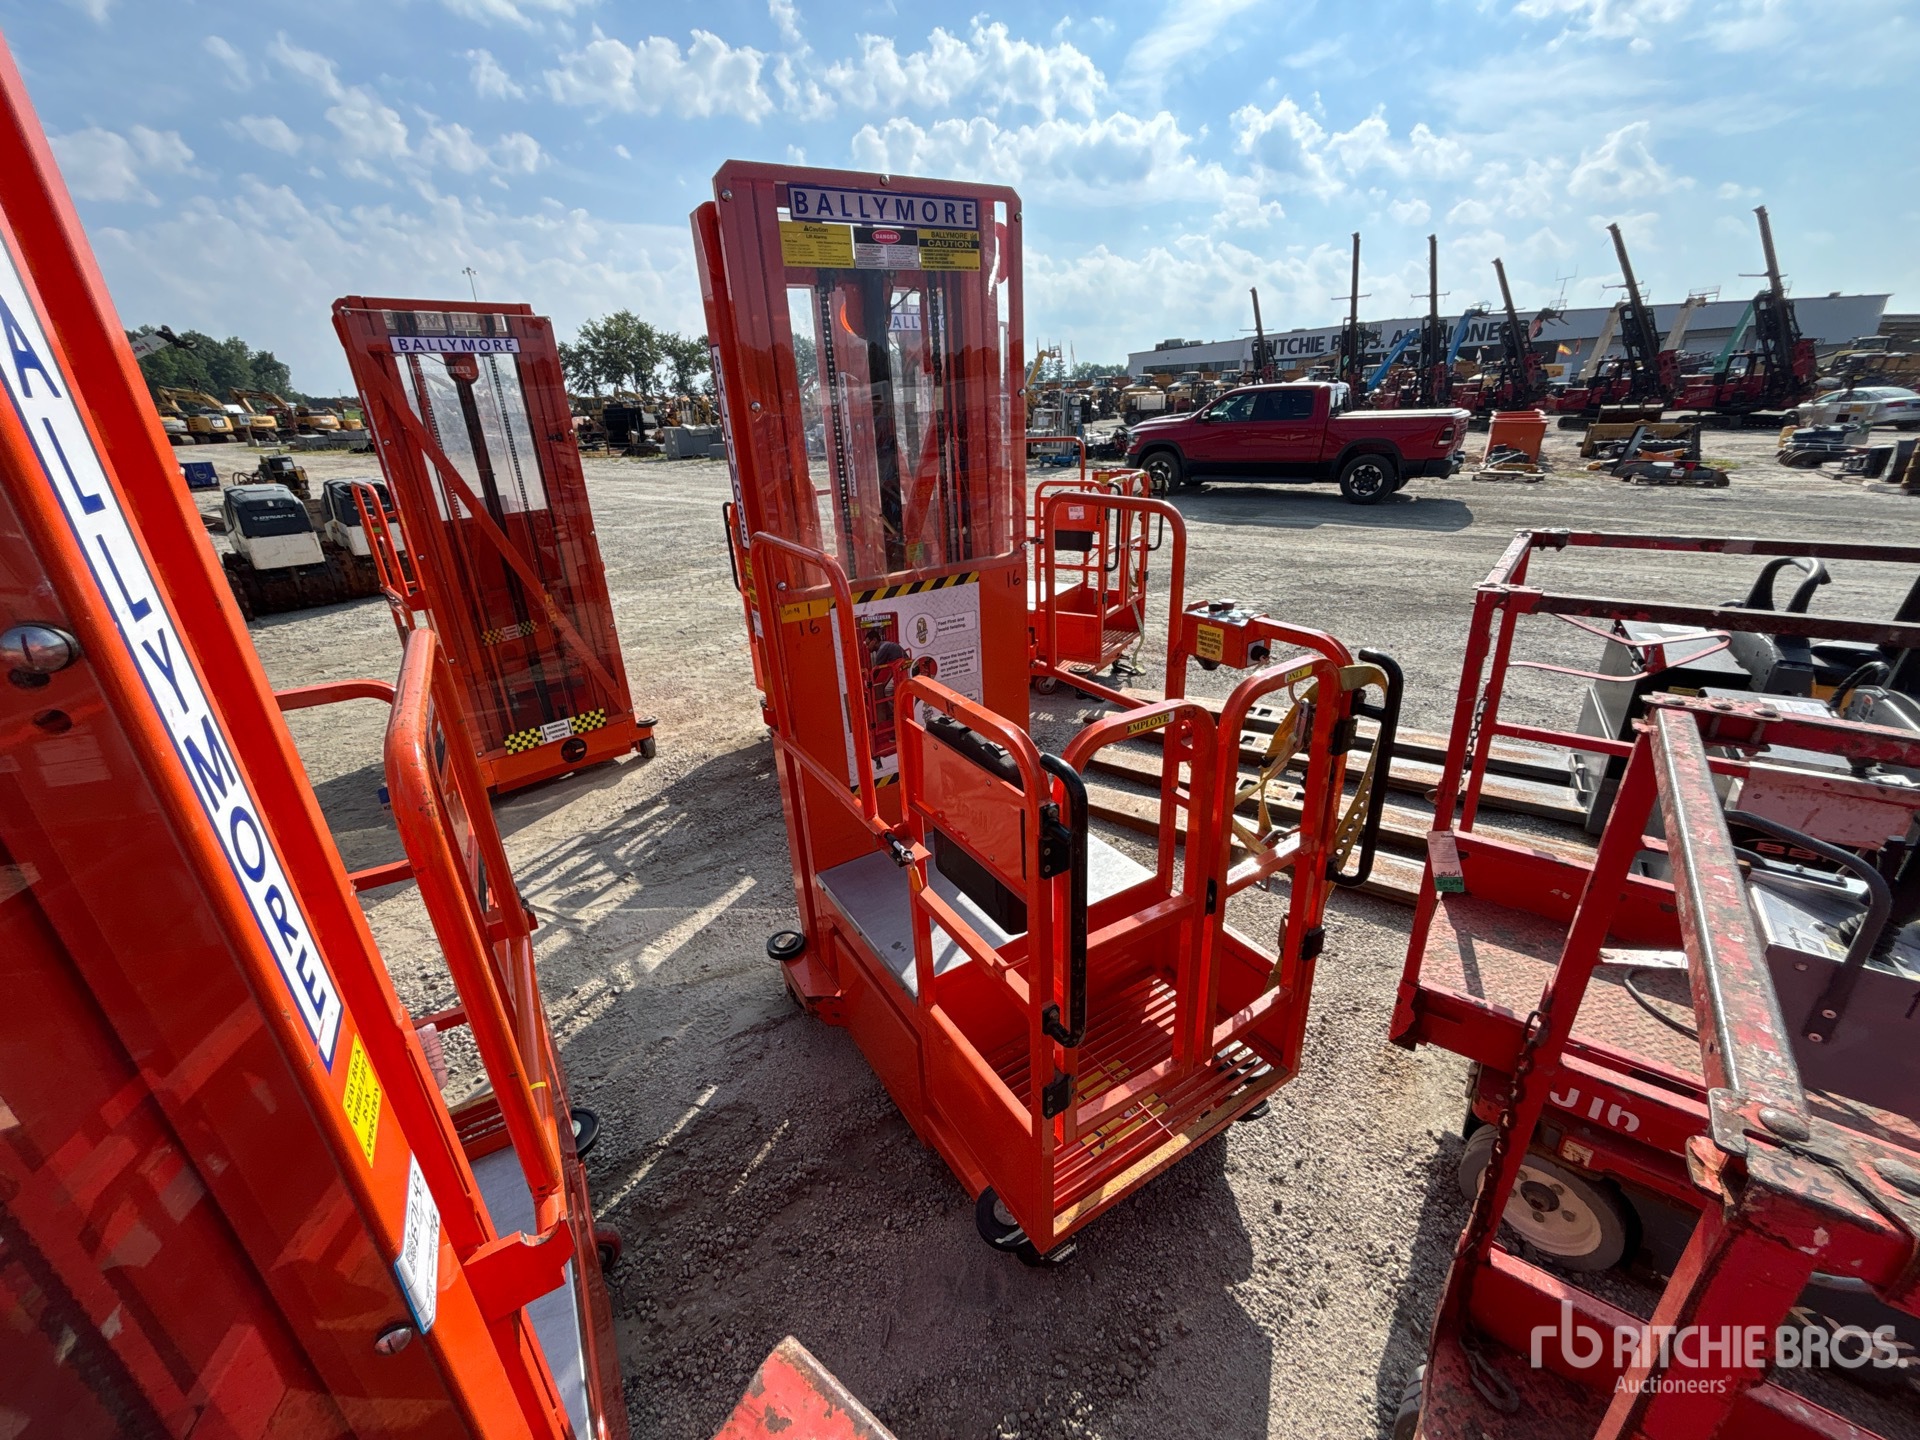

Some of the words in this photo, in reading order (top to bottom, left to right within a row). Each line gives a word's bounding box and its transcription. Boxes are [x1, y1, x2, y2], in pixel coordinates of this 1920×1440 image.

[794, 190, 974, 225] BALLYMORE
[927, 240, 972, 248] CAUTION
[931, 231, 967, 239] BALLYMORE
[398, 338, 514, 351] BALLYMORE
[1254, 336, 1325, 356] ITCHIE
[714, 354, 748, 542] BALLYMORE
[1006, 569, 1021, 588] 16
[799, 619, 820, 637] 16
[1127, 713, 1170, 734] EMPLOYE
[346, 1082, 355, 1113] STAY
[352, 1049, 361, 1080] BACK
[353, 1082, 363, 1126] WHILE
[359, 1057, 368, 1085] LIFT
[366, 1086, 379, 1157] OPERATION
